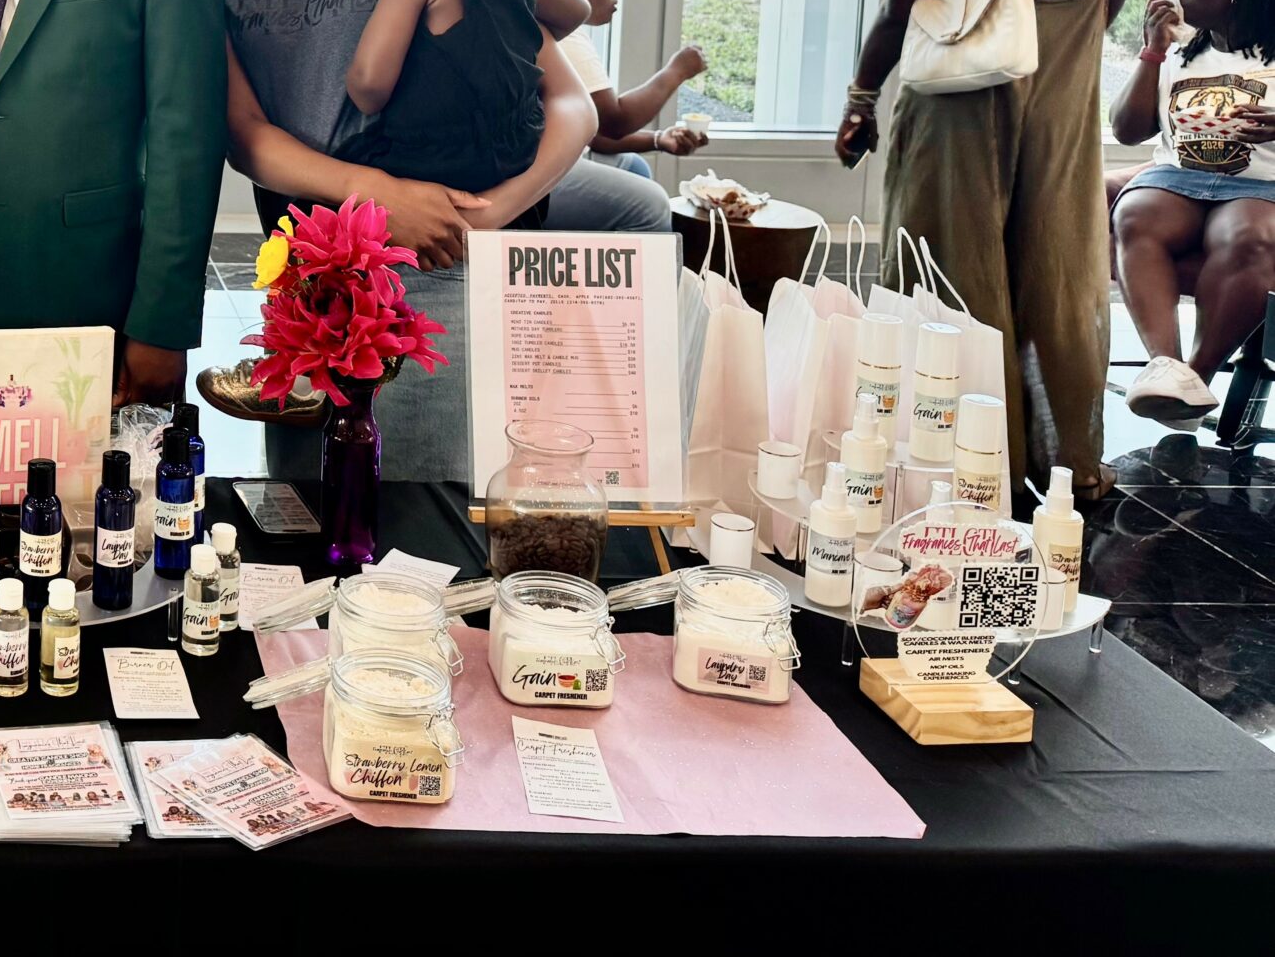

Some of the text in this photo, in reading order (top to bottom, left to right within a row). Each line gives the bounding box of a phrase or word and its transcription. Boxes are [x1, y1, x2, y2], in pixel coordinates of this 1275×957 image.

[1201, 141, 1225, 150] 2026
[509, 247, 637, 288] PRICE LIST
[913, 402, 942, 421] Gain
[845, 479, 873, 498] Gain
[961, 489, 994, 503] Chiffon
[155, 509, 177, 528] Gain
[101, 540, 133, 553] Laundry
[902, 532, 1019, 555] Fragrances That Last
[22, 552, 53, 568] Chiffon
[112, 550, 129, 562] Day
[812, 546, 851, 563] Mancave
[183, 608, 208, 626] Gain
[705, 656, 746, 674] Laundry
[512, 664, 557, 690] Gain
[717, 670, 738, 682] Day
[534, 691, 588, 700] CARPET FRESHENER
[517, 739, 546, 754] Carpet
[344, 752, 443, 772] Strawberry Lemon
[350, 768, 402, 788] Chiffon
[390, 791, 418, 799] FRESHENER
